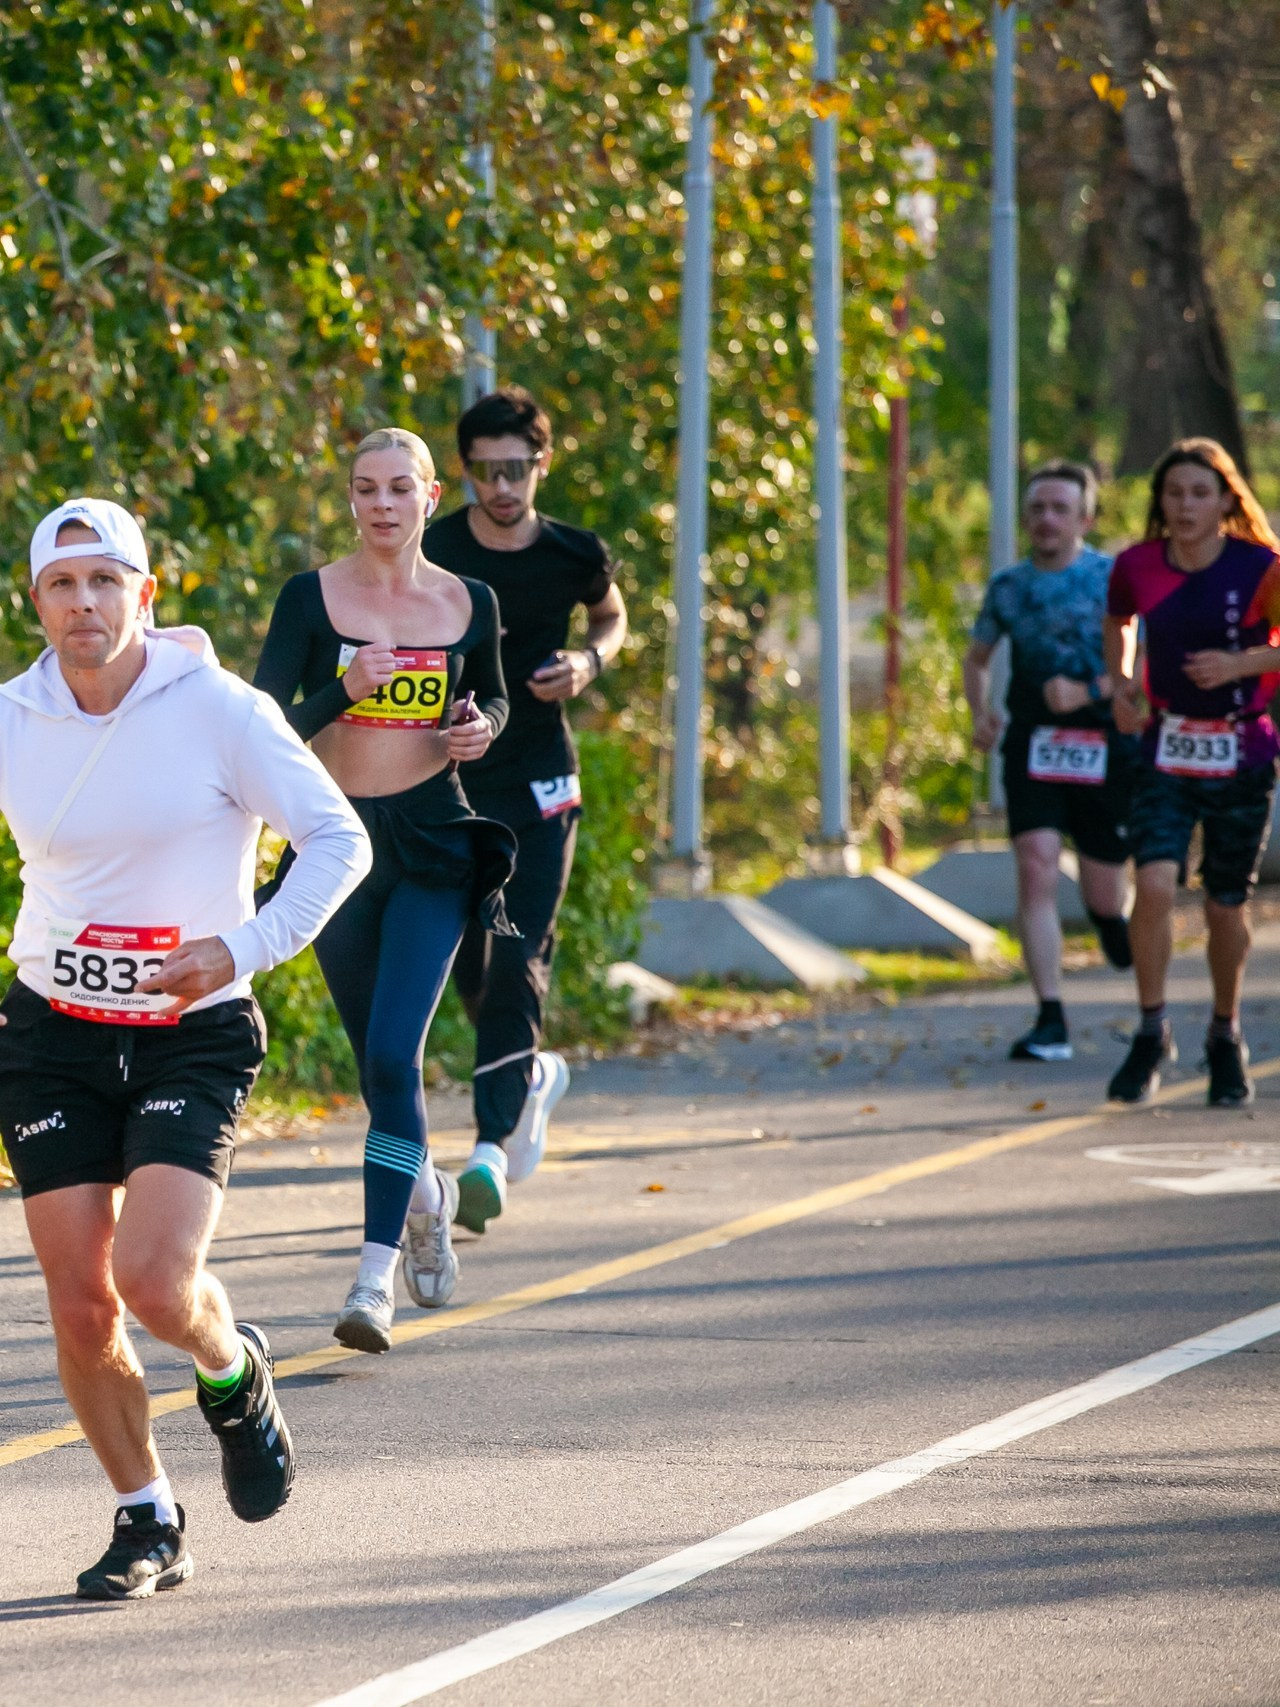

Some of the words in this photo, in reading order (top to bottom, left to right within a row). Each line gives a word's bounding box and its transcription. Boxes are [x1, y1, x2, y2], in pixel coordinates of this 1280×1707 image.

[343, 671, 441, 707] 408
[1166, 732, 1230, 760] 5933
[88, 930, 138, 940] КРАСНОЯРСКИЕ
[100, 936, 124, 945] МОСТЫ
[70, 991, 119, 1005] СИДОРЕНКО
[120, 997, 150, 1006] ДЕНИС
[21, 1115, 59, 1138] ASRV
